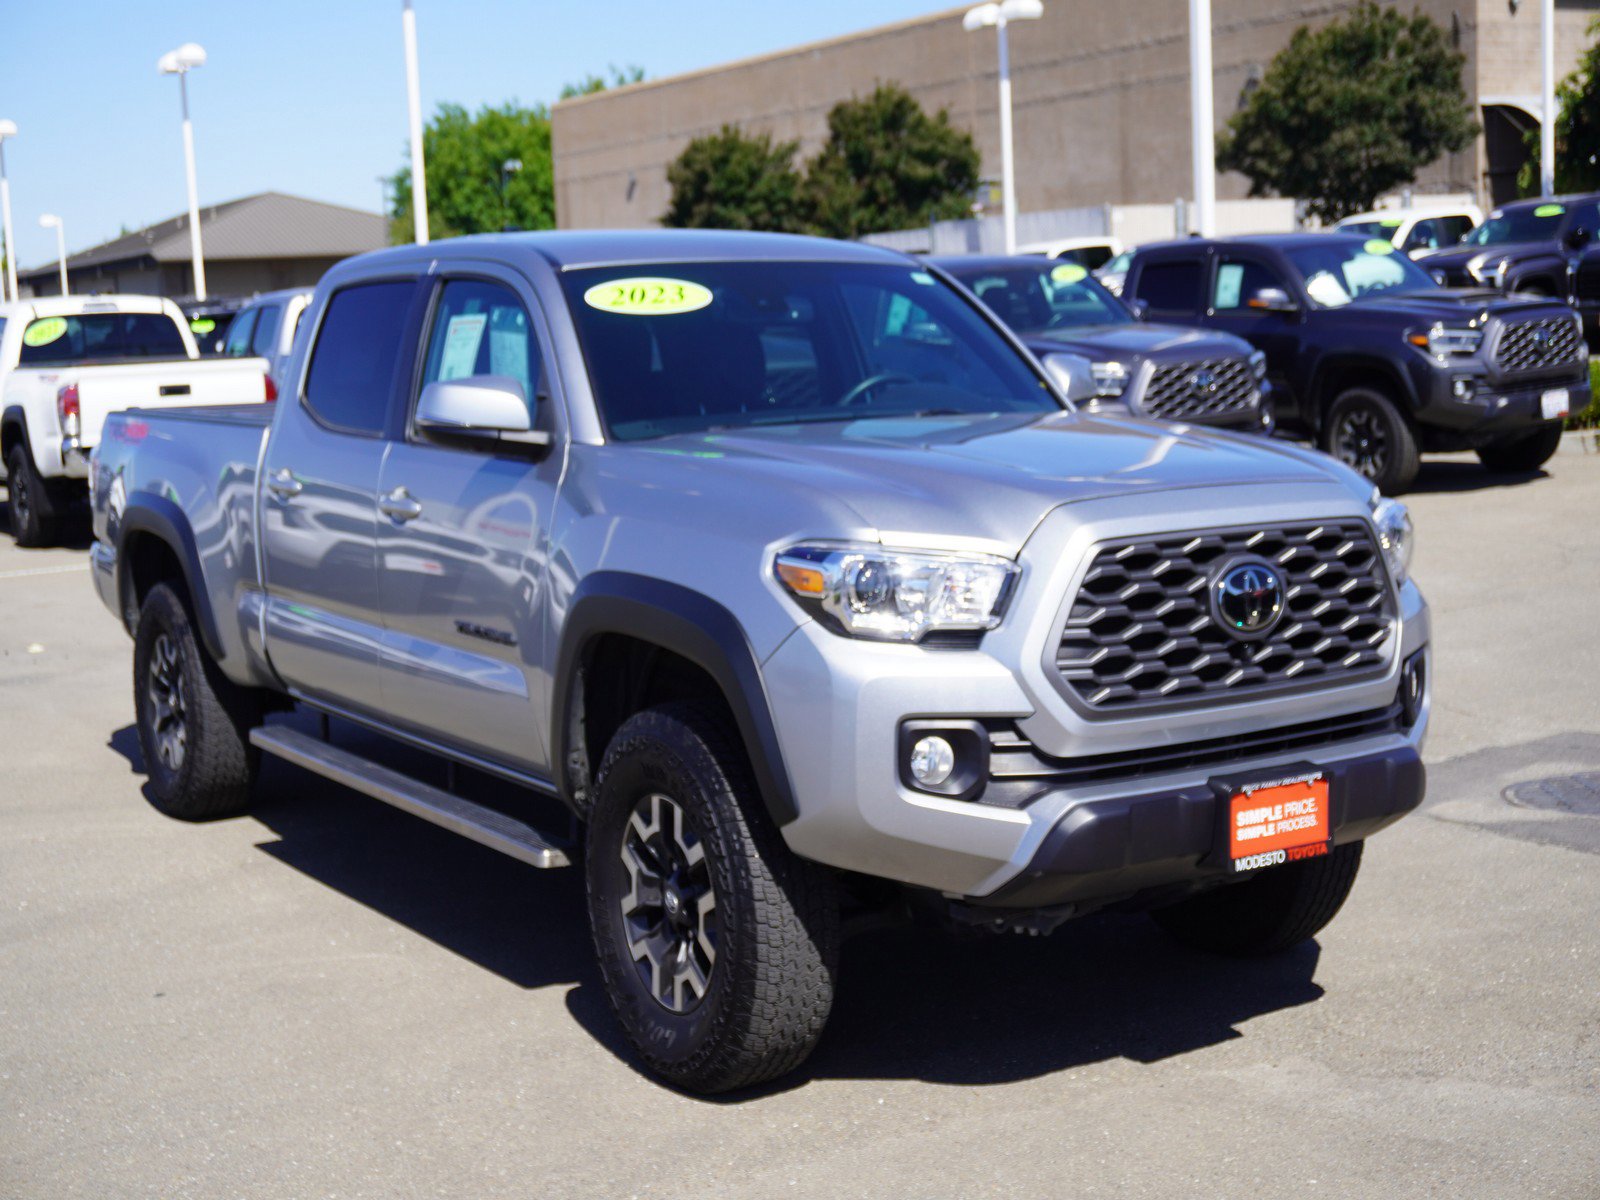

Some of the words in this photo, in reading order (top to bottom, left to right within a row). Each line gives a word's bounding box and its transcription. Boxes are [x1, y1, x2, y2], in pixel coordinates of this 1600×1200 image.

[610, 285, 685, 306] 2023
[1237, 805, 1282, 827] SIMPLE
[1284, 798, 1318, 817] PRICE.
[1237, 823, 1276, 841] SIMPLE
[1276, 814, 1318, 833] PROCESS.
[1234, 849, 1286, 872] MODESTO
[1287, 842, 1328, 861] TOYOTA
